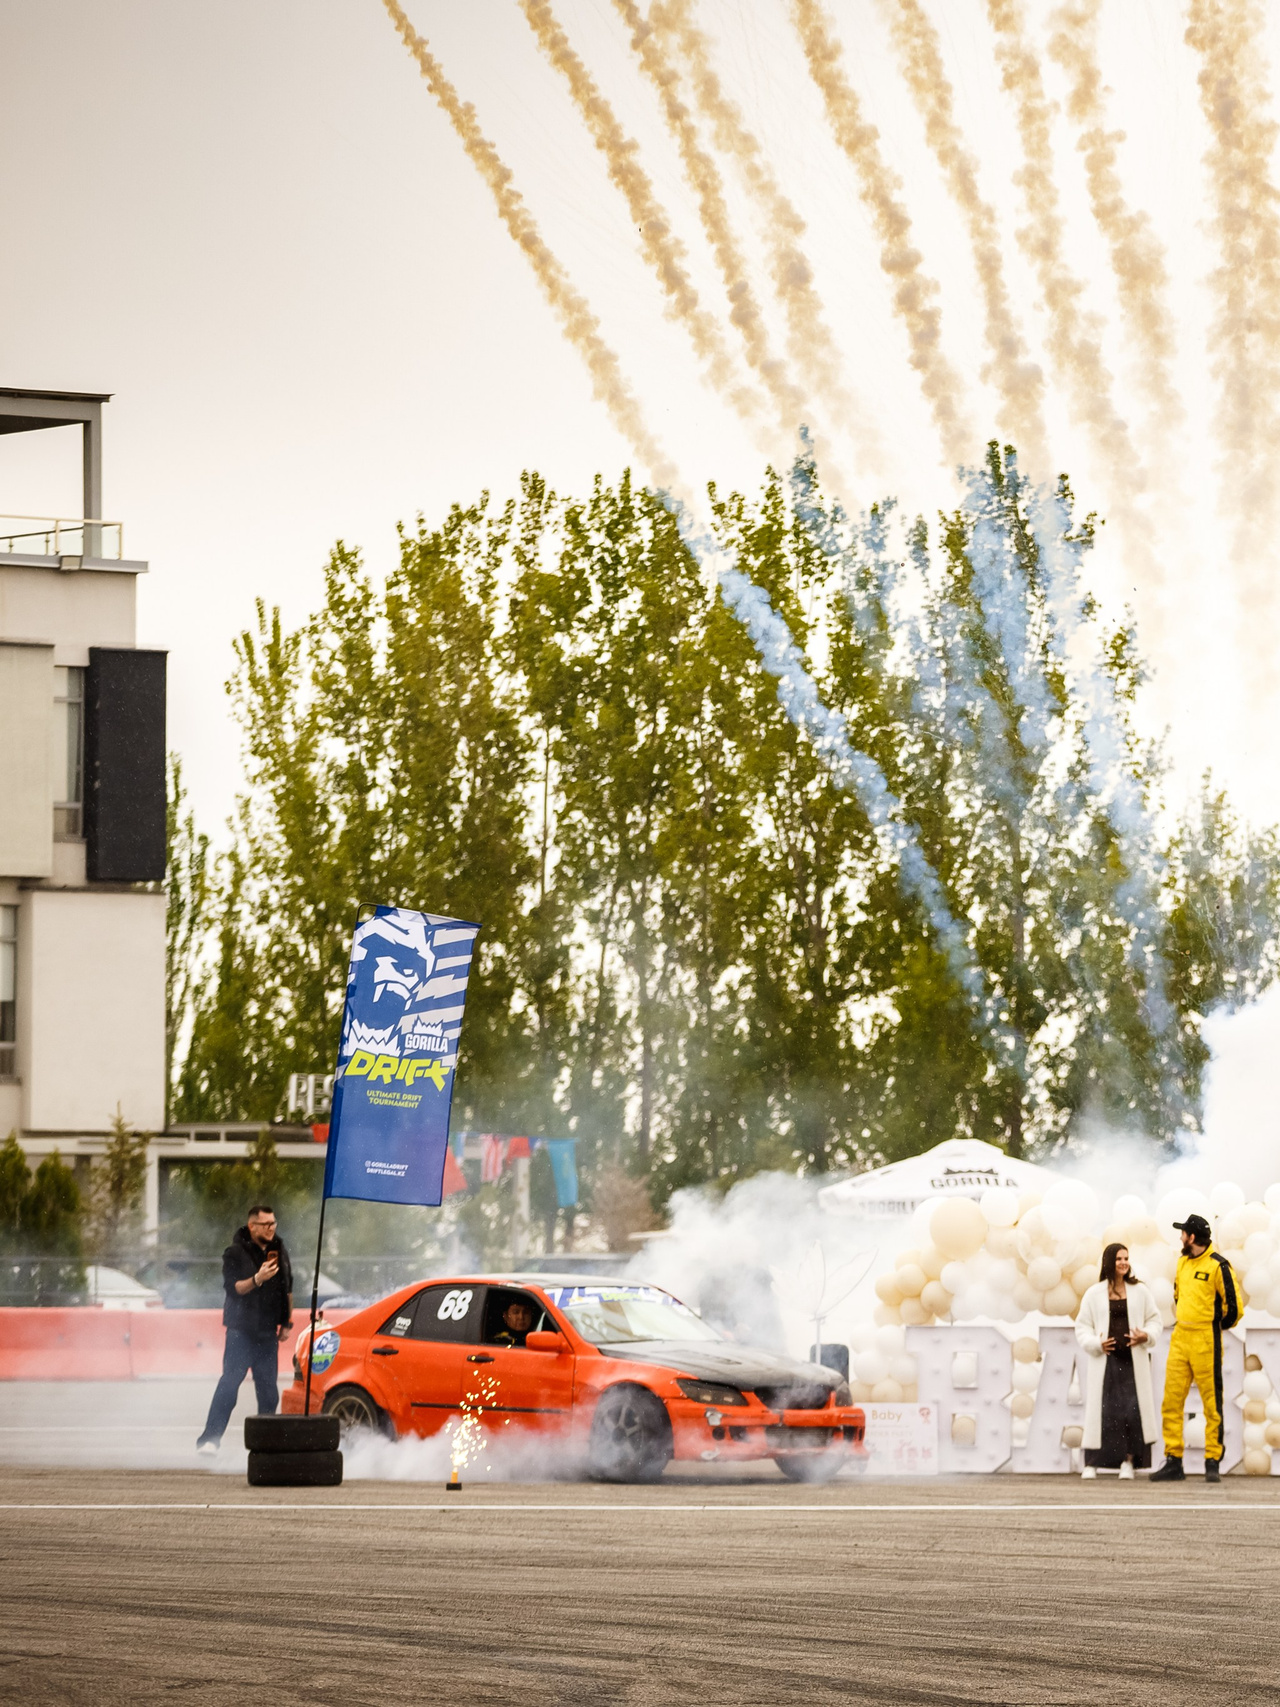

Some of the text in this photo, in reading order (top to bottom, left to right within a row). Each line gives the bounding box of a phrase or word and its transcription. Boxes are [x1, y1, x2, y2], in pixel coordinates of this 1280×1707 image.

[404, 1033, 450, 1053] GORILLA
[344, 1050, 451, 1092] DRIFT
[366, 1089, 423, 1102] ULTIMATE DRIFT
[369, 1097, 419, 1109] TOURNAMENT
[930, 1176, 1019, 1189] GORILLA
[437, 1289, 473, 1321] 68
[871, 1408, 903, 1423] Baby
